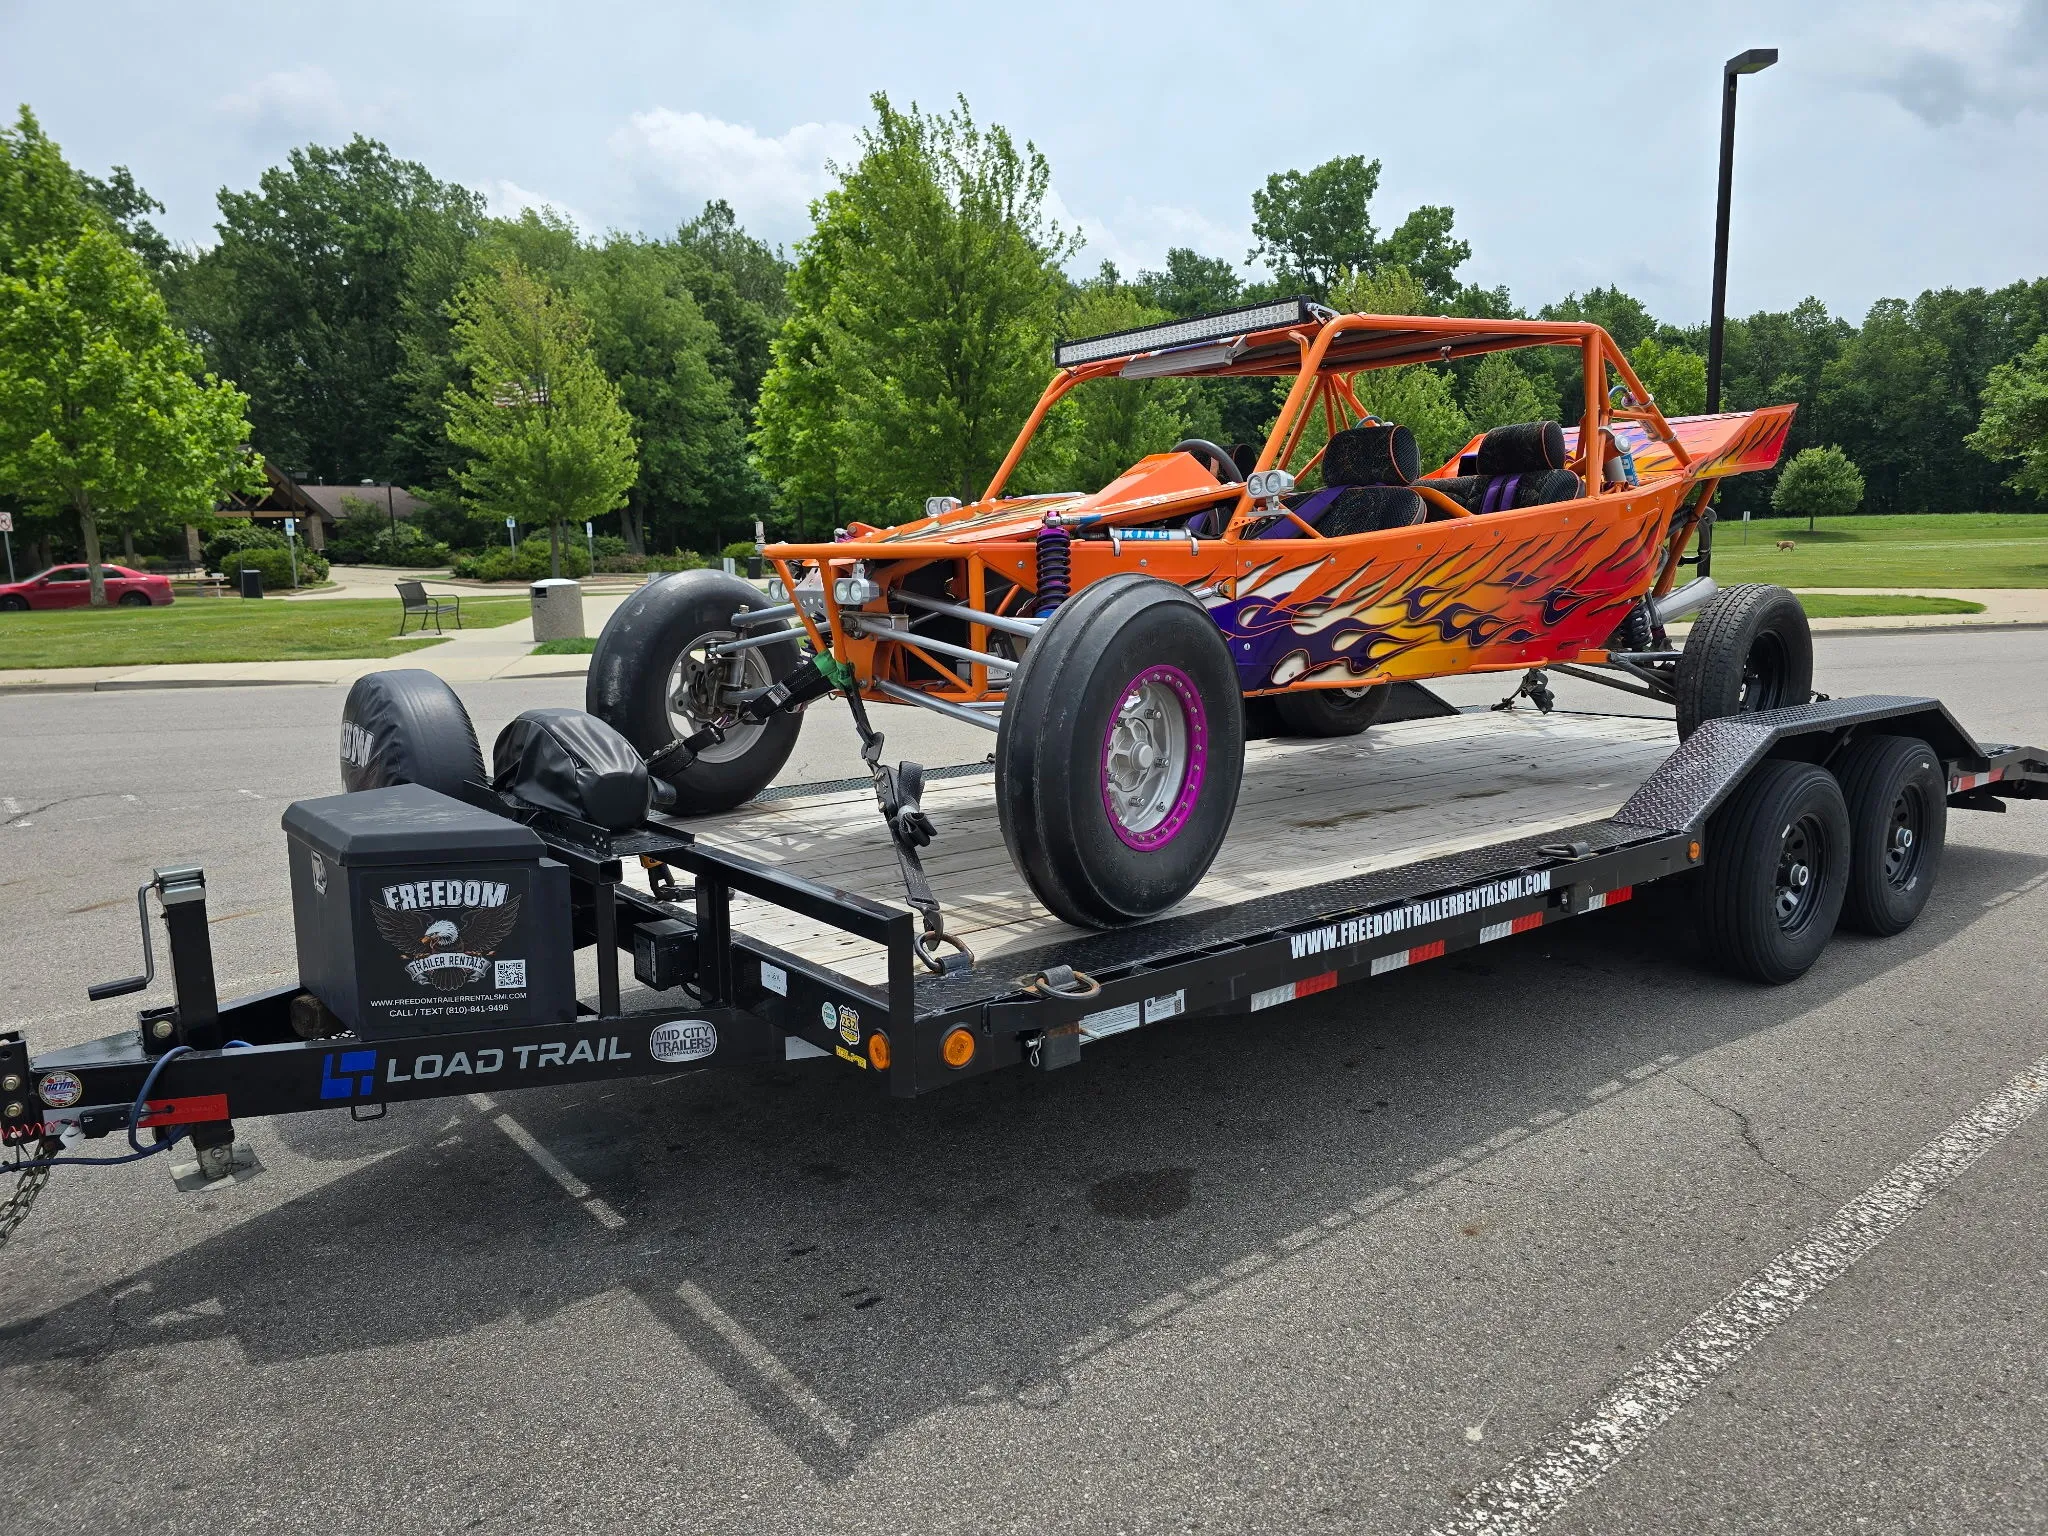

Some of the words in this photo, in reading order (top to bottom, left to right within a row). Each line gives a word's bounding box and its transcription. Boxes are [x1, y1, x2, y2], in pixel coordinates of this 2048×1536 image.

[1123, 530, 1168, 540] KING
[382, 880, 509, 911] FREEDOM
[1291, 871, 1551, 959] WWW.FREEDOMTRAILERRENTALSMI.COM
[410, 957, 445, 974] TRAILER
[449, 955, 484, 970] RENTALS
[371, 992, 527, 1007] WWW.FREEDOMTRAILERRENTALSMI.COM
[389, 1009, 413, 1018] CALL
[420, 1007, 443, 1016] TEXT
[656, 1029, 680, 1041] MID
[683, 1026, 710, 1039] CITY
[656, 1037, 711, 1053] TRAILERS
[387, 1049, 504, 1083] LOAD
[512, 1036, 632, 1070] TRAIL
